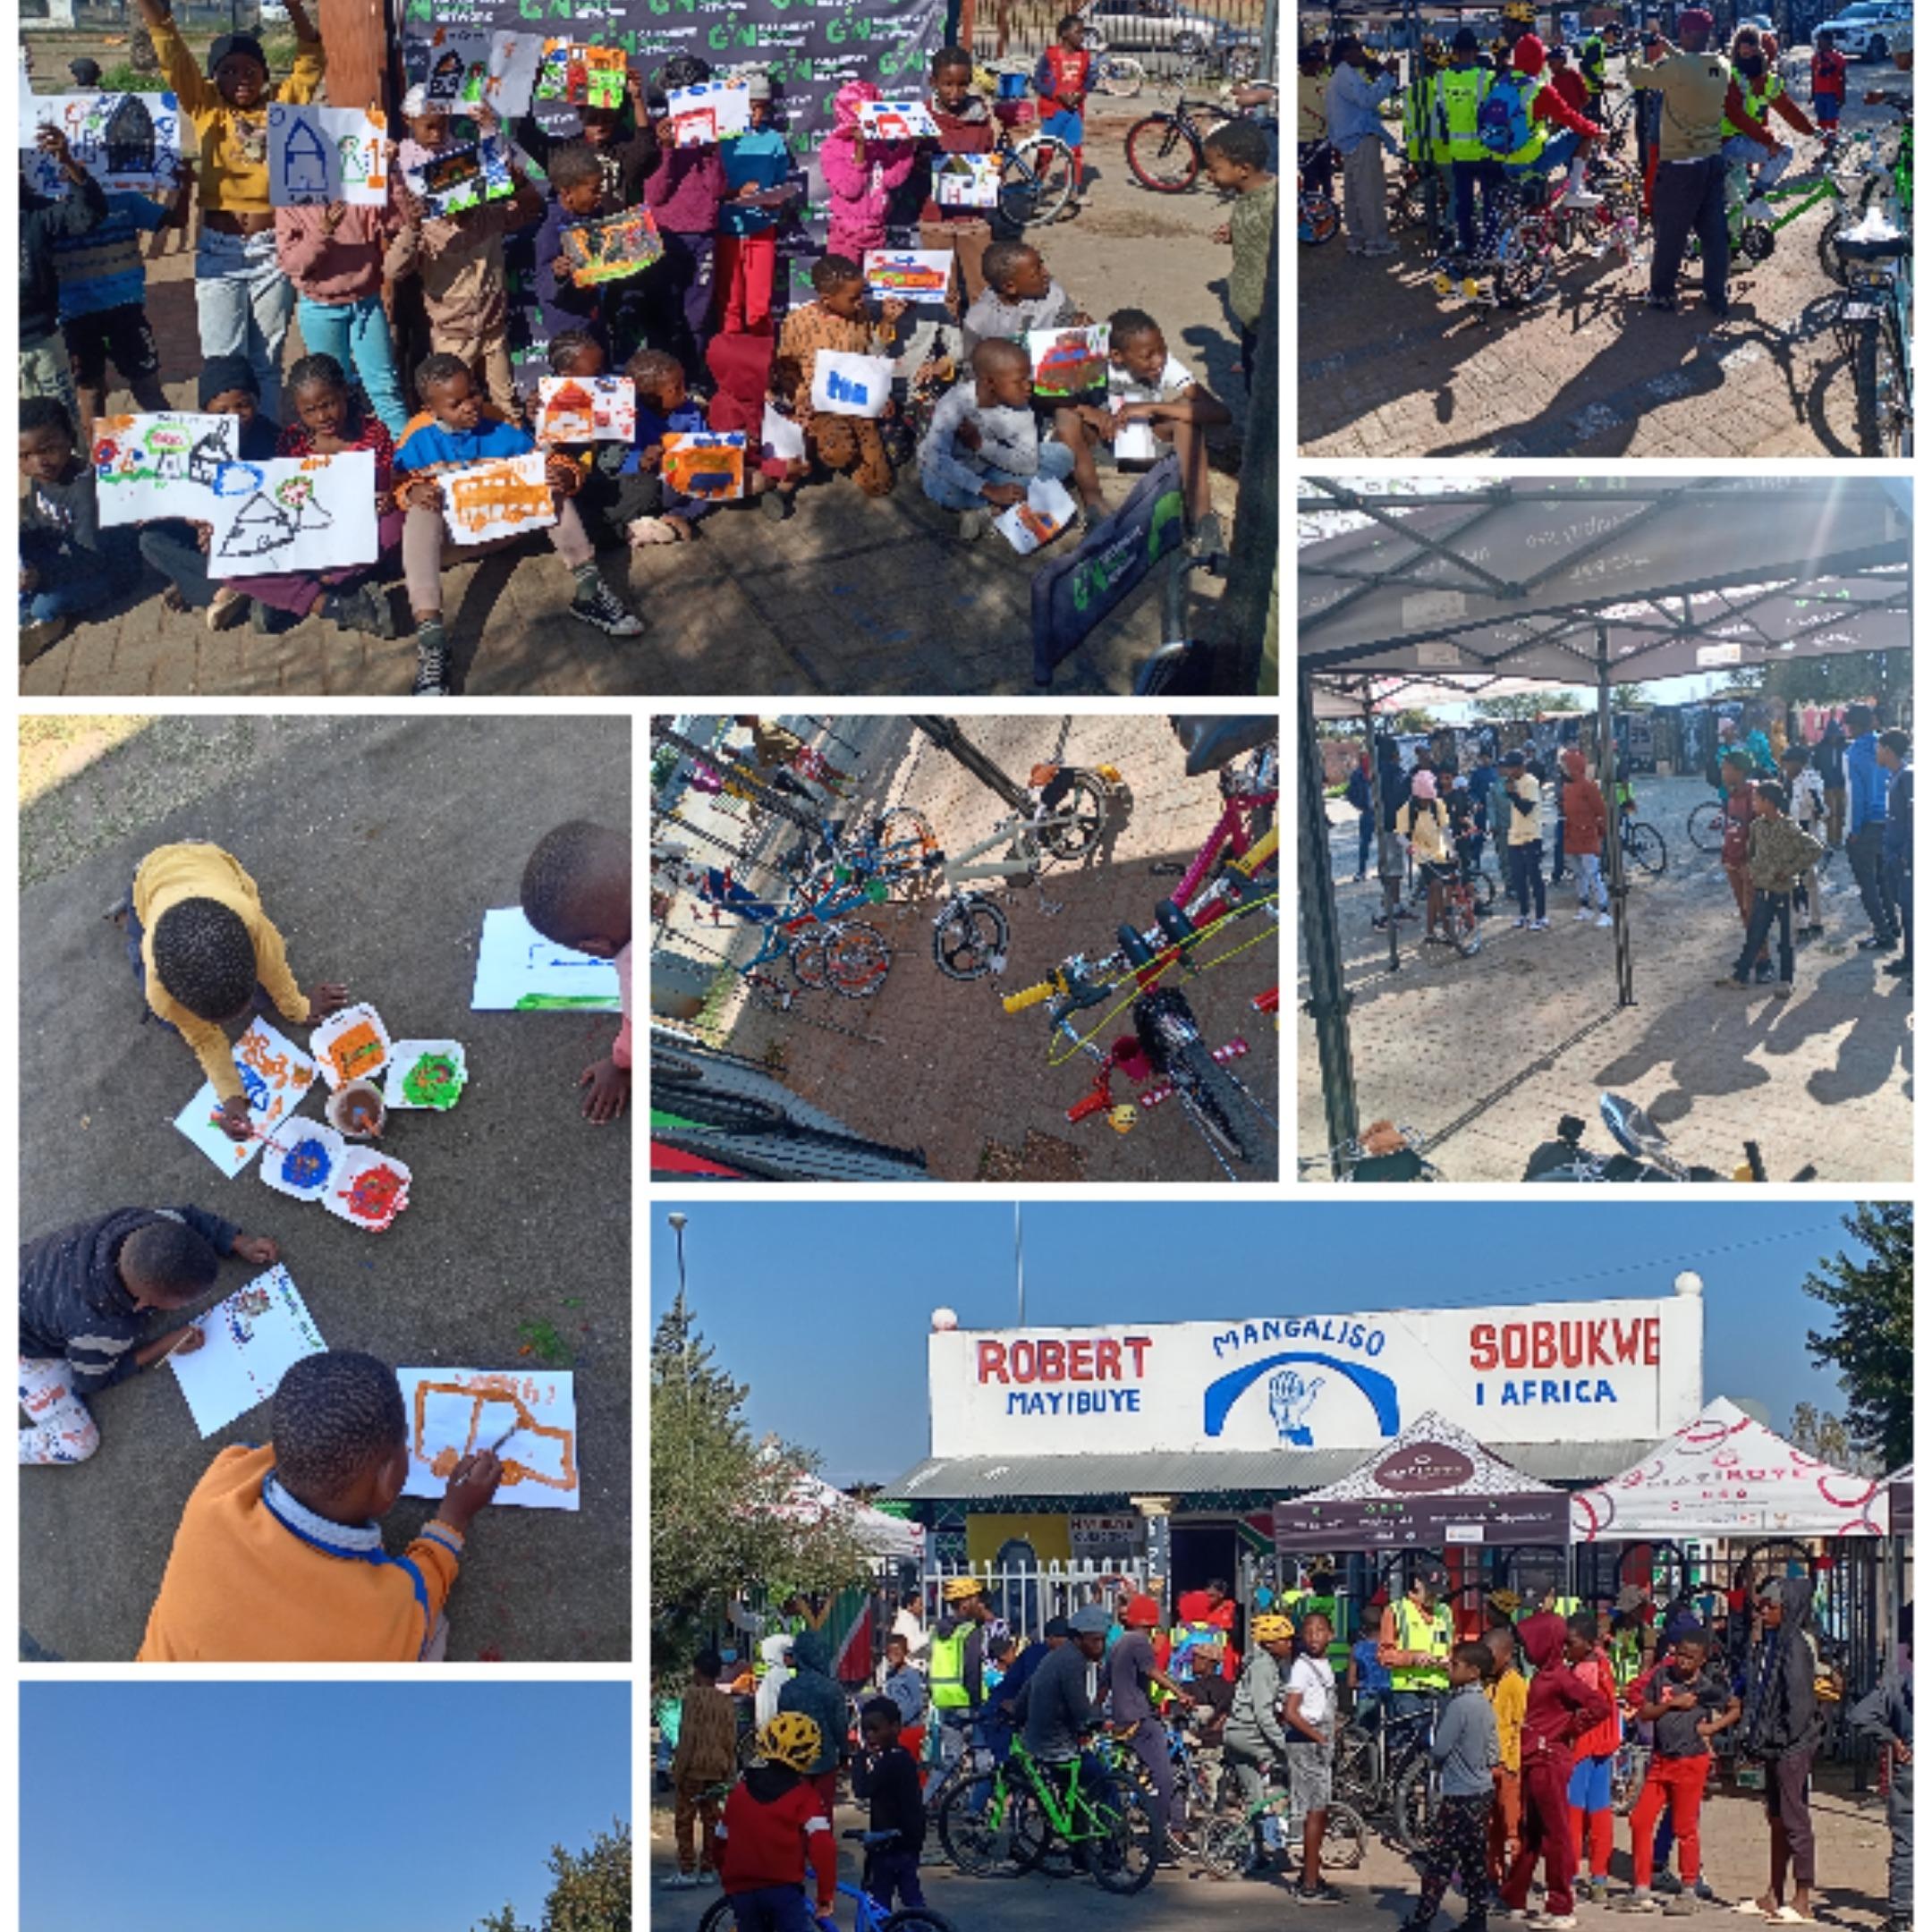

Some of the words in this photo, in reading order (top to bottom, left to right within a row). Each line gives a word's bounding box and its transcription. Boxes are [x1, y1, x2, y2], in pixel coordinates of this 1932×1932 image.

[977, 1336, 1153, 1385] ROBERT
[1213, 1318, 1385, 1360] MANGALISO
[1469, 1317, 1660, 1371] SOBUKWE
[1006, 1388, 1141, 1416] MAYIBUYE
[1476, 1381, 1485, 1406] I
[1501, 1378, 1618, 1406] AFRICA
